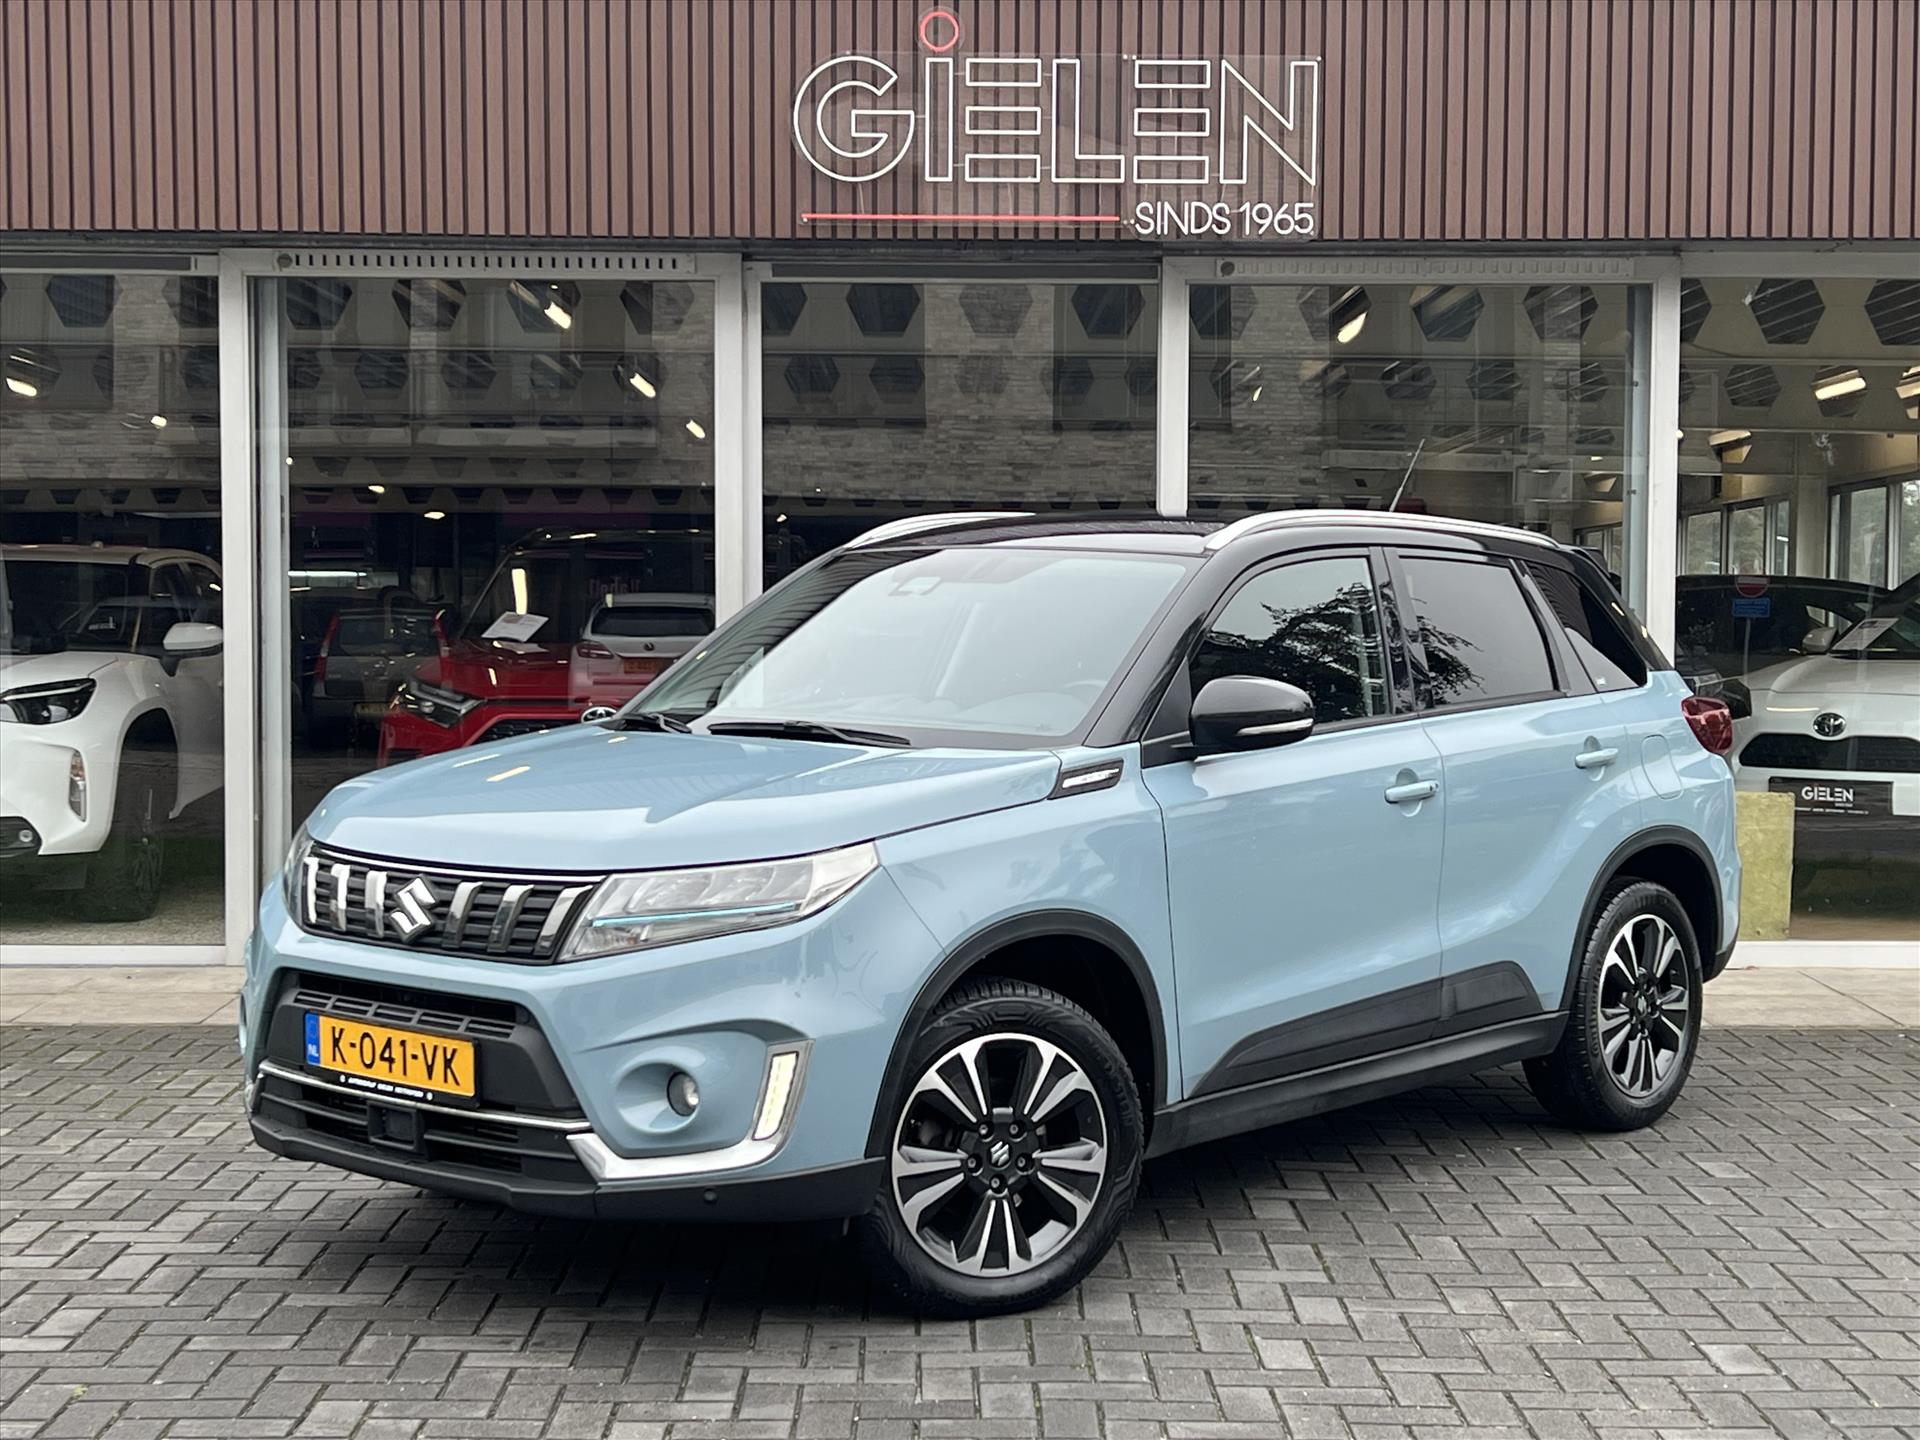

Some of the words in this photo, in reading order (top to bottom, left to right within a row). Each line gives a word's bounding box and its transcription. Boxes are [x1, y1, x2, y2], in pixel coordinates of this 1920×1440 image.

[794, 12, 1318, 187] GIELEN
[1135, 201, 1231, 236] SINDS
[1238, 202, 1315, 236] 1965
[1801, 785, 1854, 802] GIELEN
[307, 1043, 319, 1057] NL
[331, 1025, 461, 1087] K-041-VK
